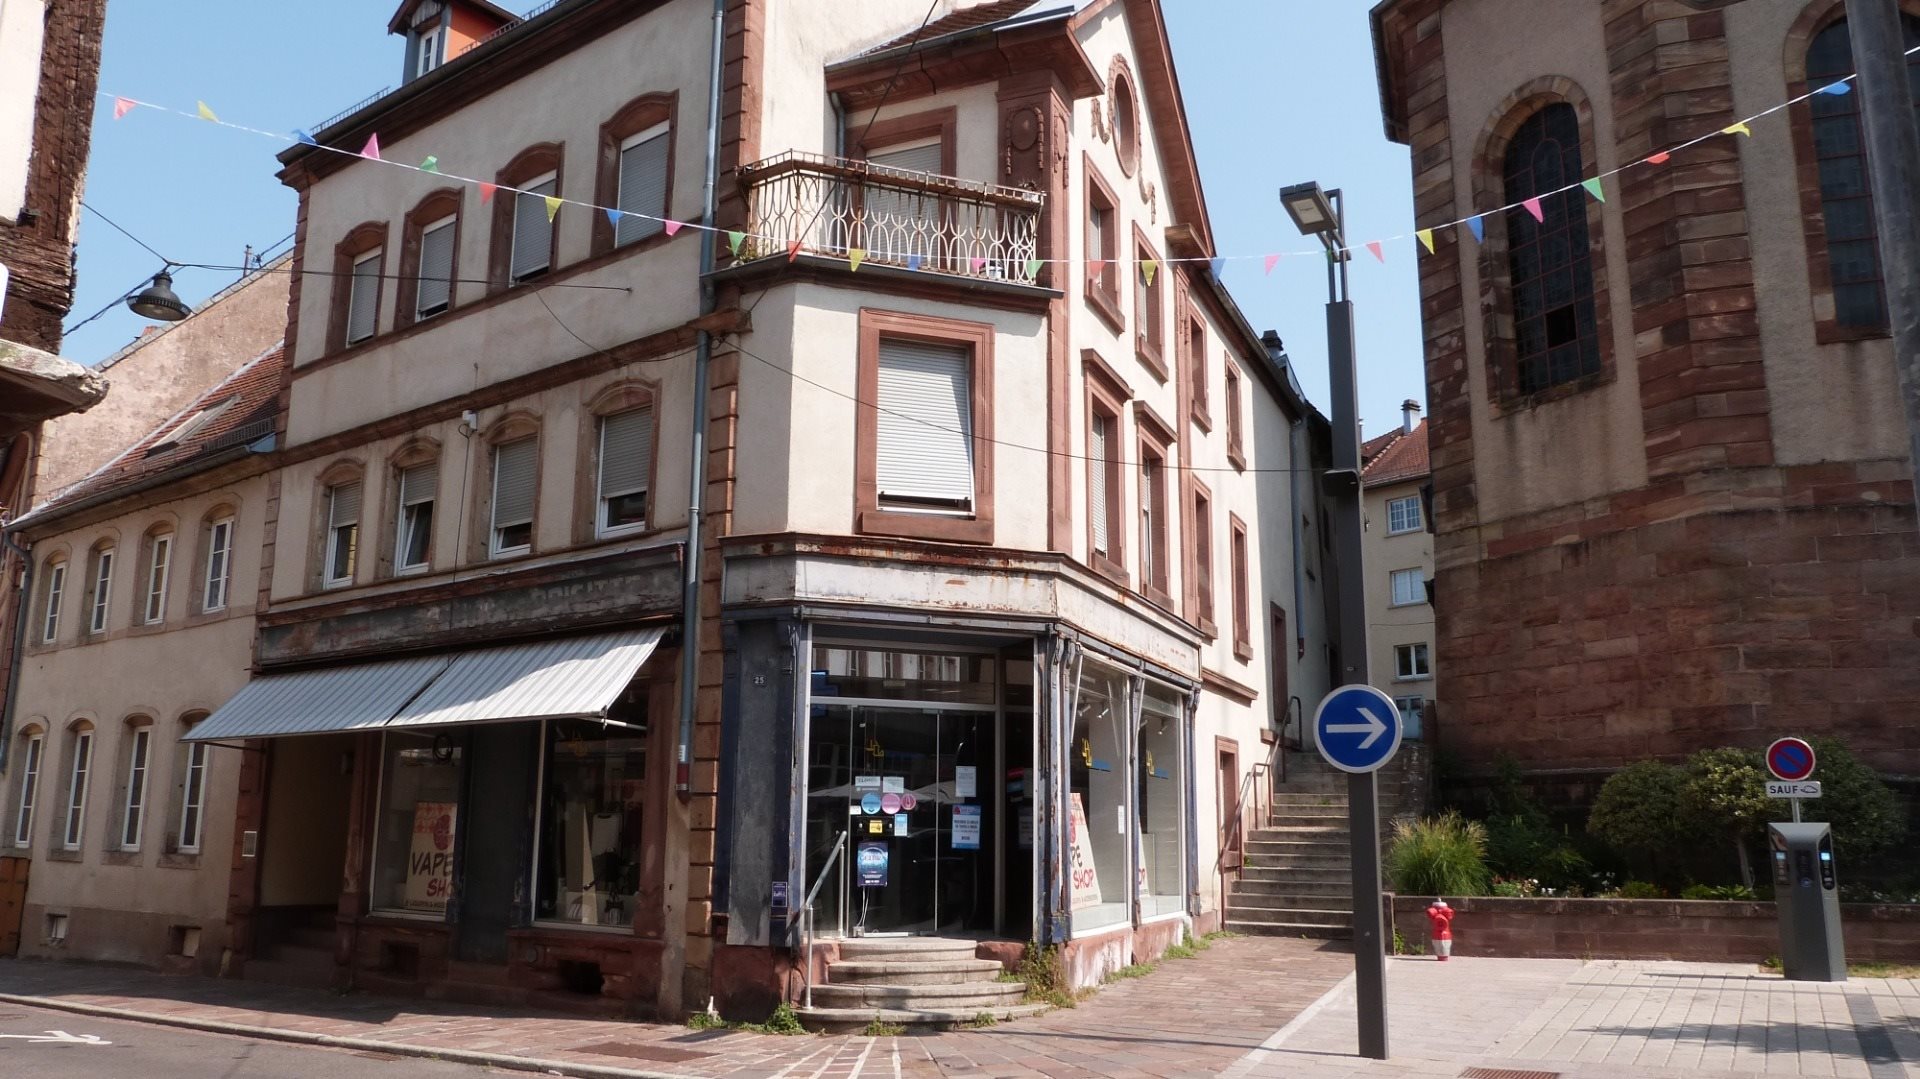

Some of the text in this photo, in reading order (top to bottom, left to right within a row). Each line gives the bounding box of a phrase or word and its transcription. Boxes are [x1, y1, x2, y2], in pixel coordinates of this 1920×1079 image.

[754, 676, 764, 684] 25
[1769, 785, 1798, 794] SAUF
[412, 852, 452, 876] VAPE
[1070, 845, 1083, 868] PE
[1073, 869, 1094, 890] SHOP
